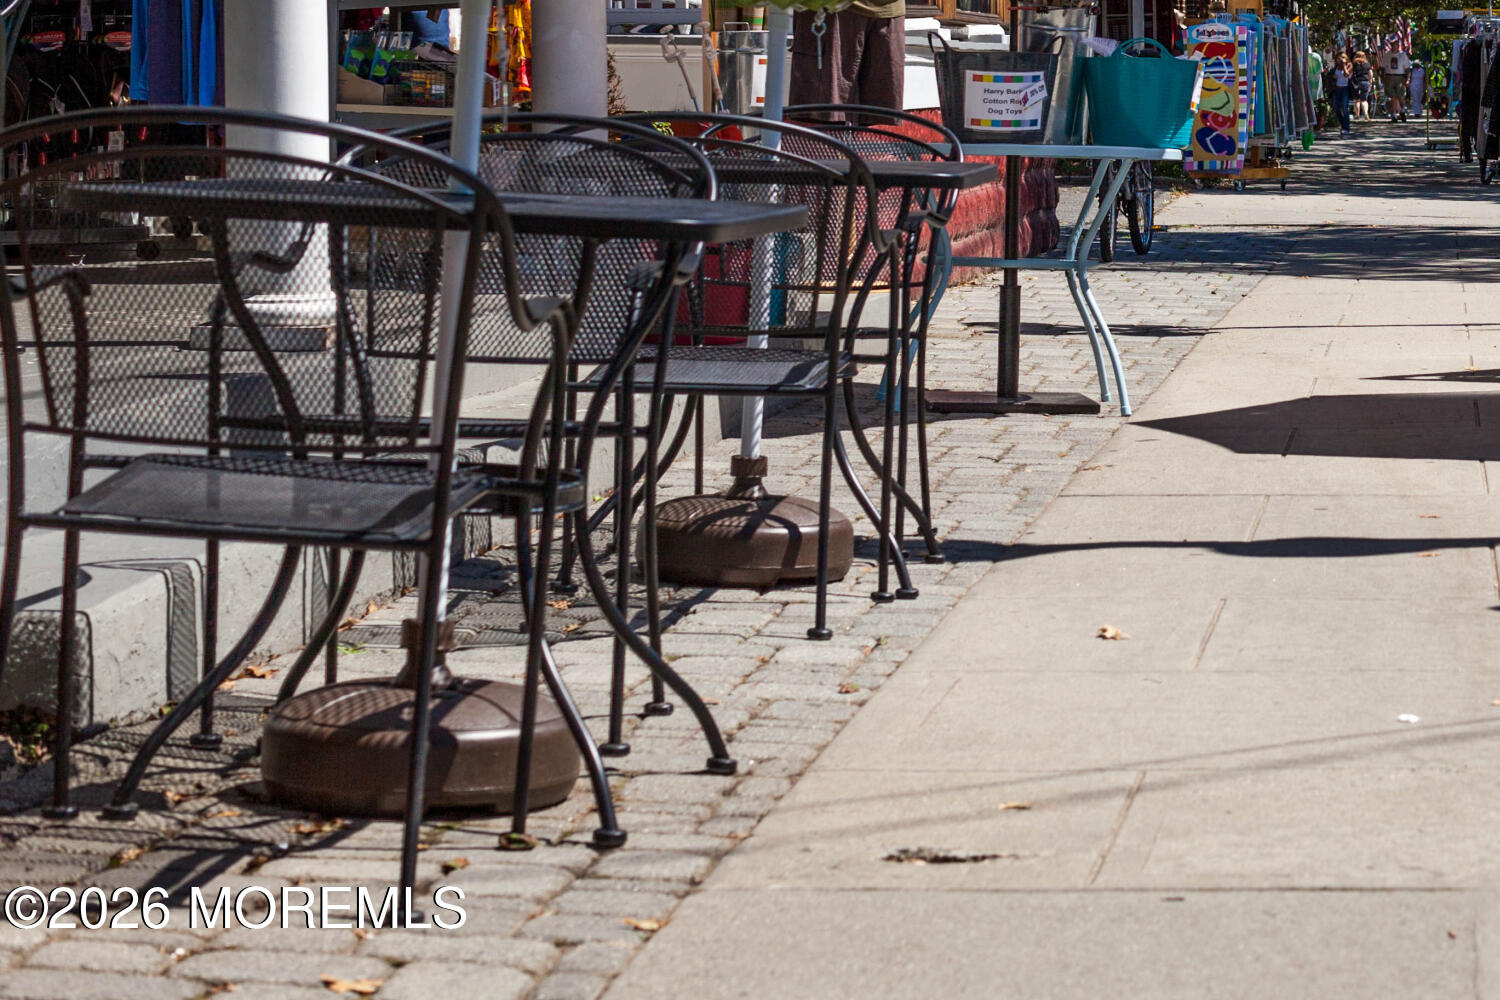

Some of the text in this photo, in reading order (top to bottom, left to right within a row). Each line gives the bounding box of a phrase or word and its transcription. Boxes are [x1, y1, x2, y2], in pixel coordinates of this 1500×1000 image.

[983, 87, 1005, 96] Harry
[982, 97, 1022, 106] Cotton Rop
[987, 107, 1022, 116] Dog Toys
